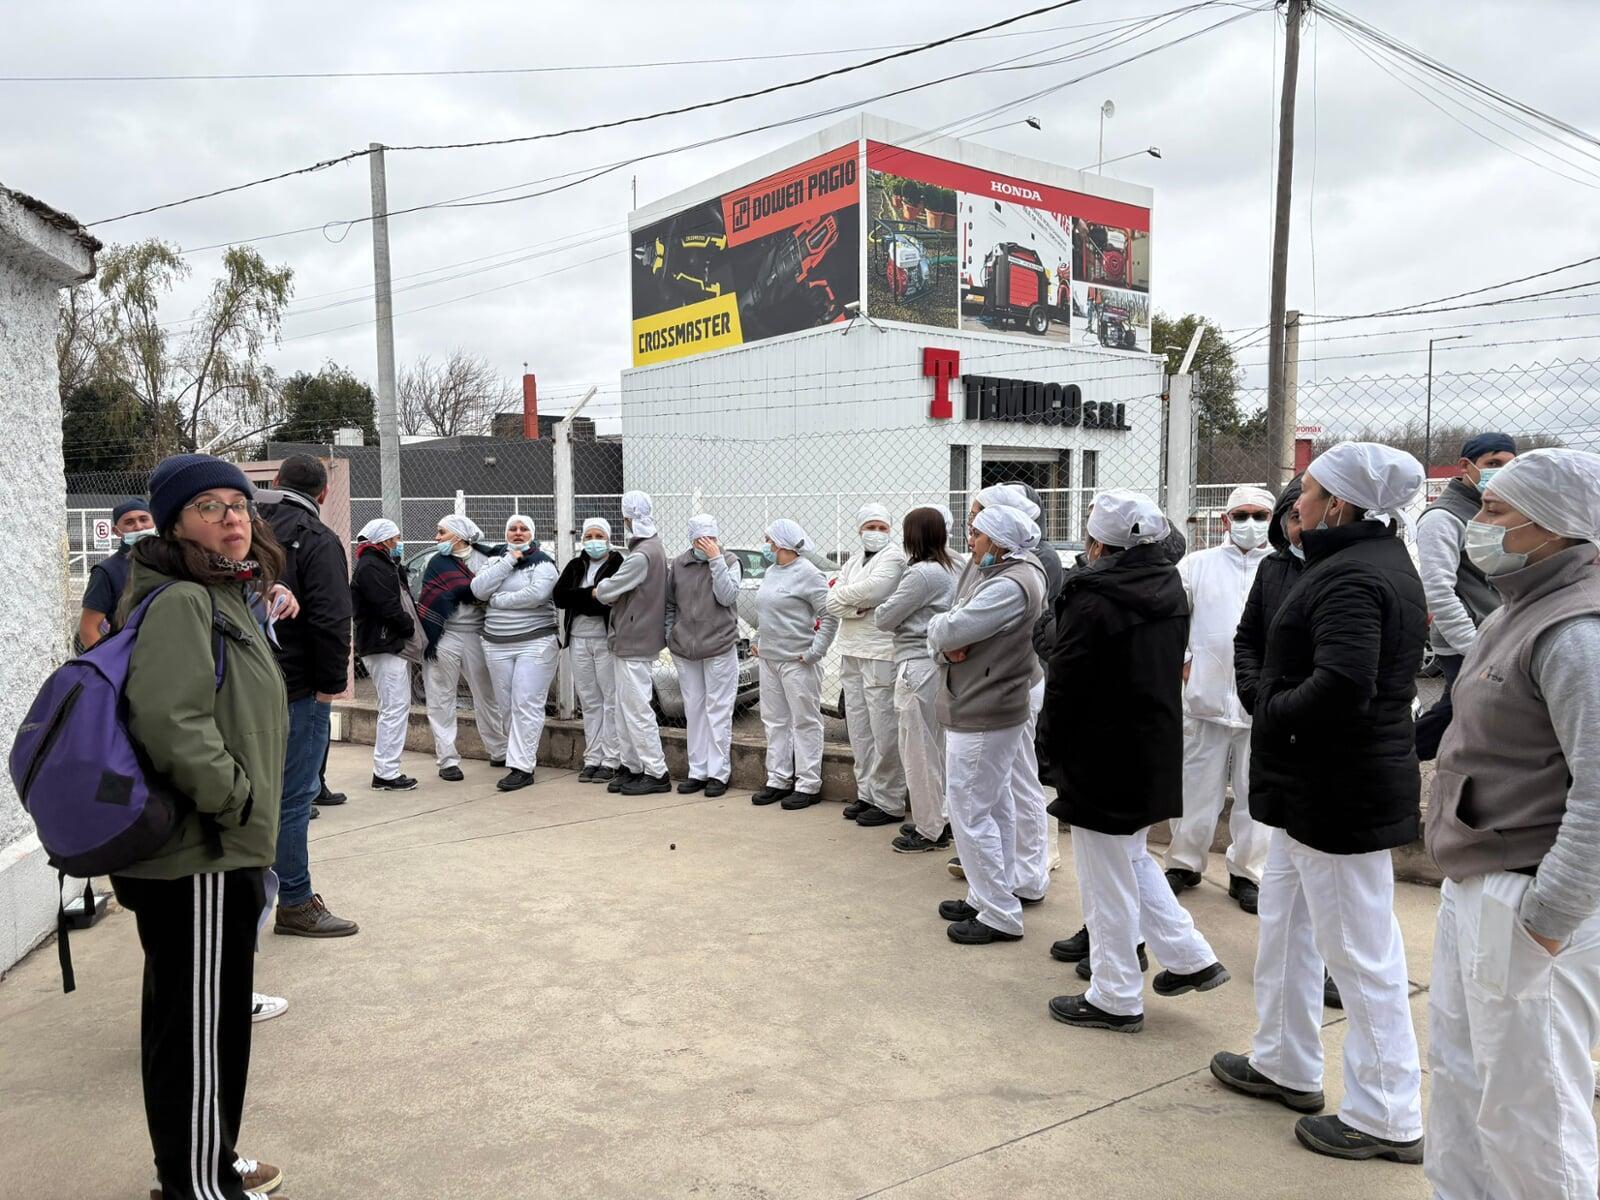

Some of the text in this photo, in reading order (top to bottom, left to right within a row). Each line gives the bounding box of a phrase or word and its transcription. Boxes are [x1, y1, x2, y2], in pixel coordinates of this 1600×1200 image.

[753, 179, 804, 221] DOWEN
[807, 159, 856, 200] PAGIO
[990, 180, 1042, 202] HONDA
[638, 311, 731, 354] CROSSMASTER
[962, 374, 1082, 428] TEMUCO
